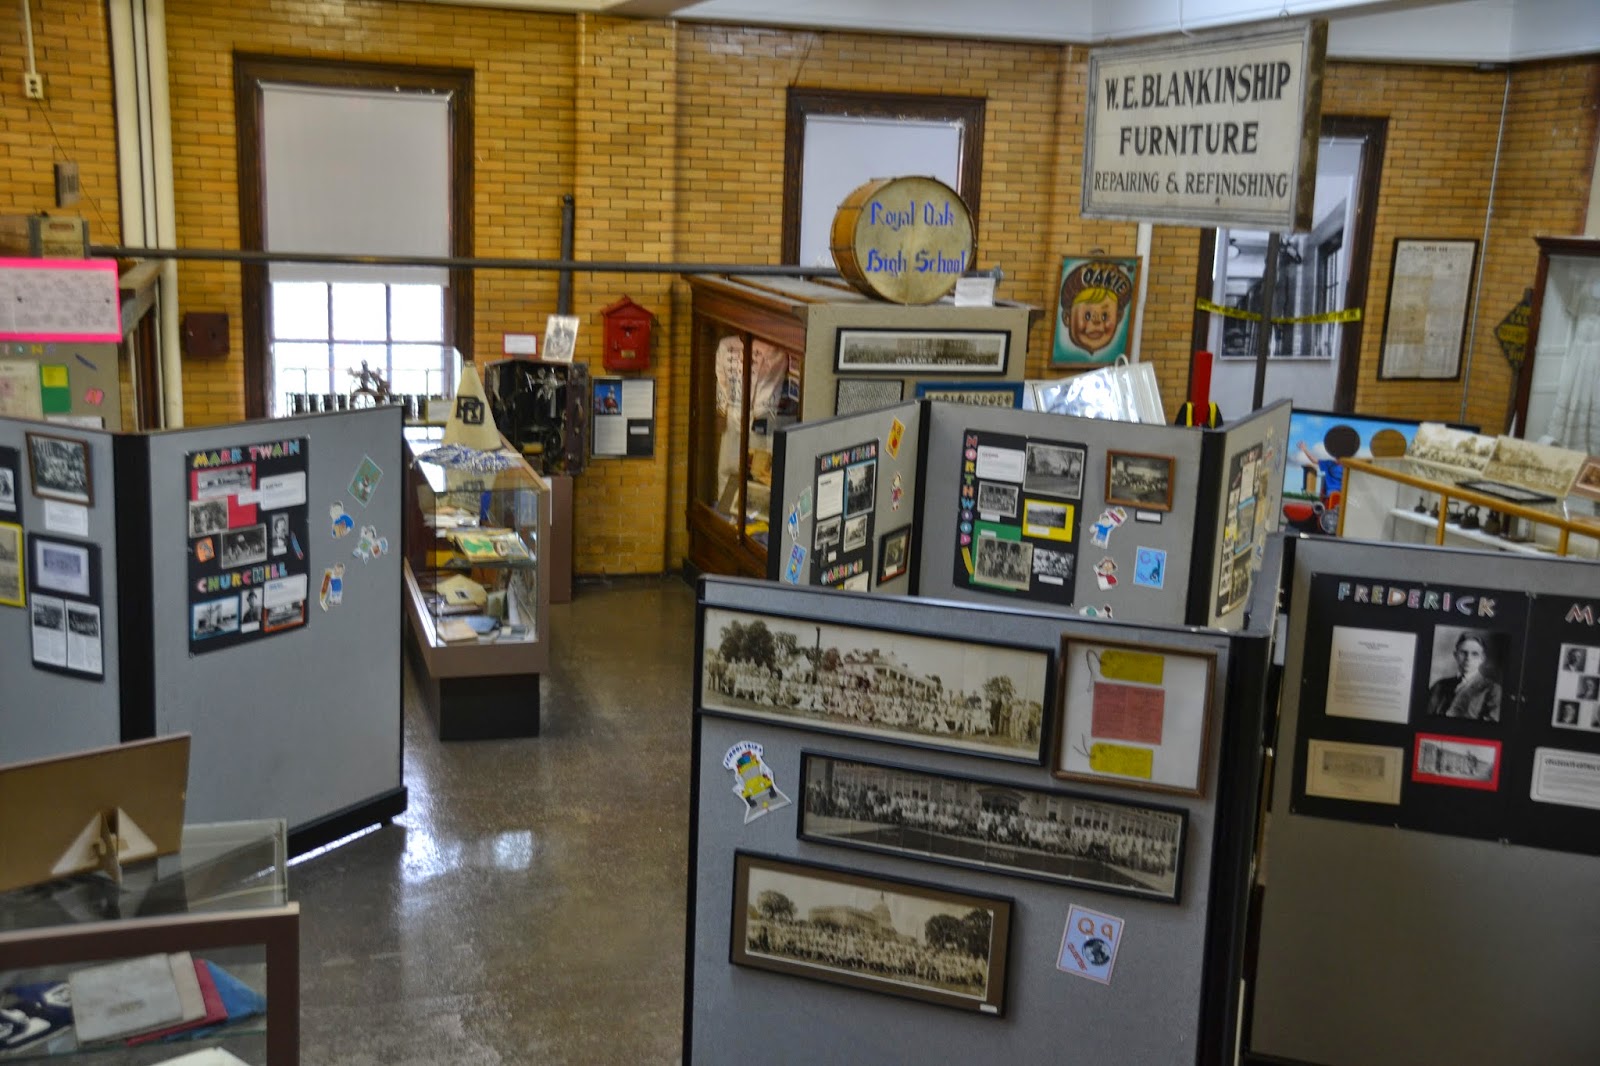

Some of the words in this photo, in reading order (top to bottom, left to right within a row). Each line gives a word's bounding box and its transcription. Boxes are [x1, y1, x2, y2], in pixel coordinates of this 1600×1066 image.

[1119, 121, 1259, 157] FURNITURE
[1094, 171, 1160, 195] REPAIRING
[1166, 172, 1180, 195] &
[1185, 171, 1289, 199] REFINISHING
[870, 200, 915, 232] Royal
[923, 200, 955, 226] Oak
[865, 248, 907, 278] High
[914, 249, 966, 274] School
[1081, 267, 1128, 293] OAKIE
[193, 447, 243, 468] MARK
[249, 440, 300, 461] TWAIN
[821, 453, 849, 472] EDWIN
[850, 443, 876, 463] STARR
[960, 434, 978, 545] NORTHWOOD
[197, 562, 288, 593] CHURCHILL
[1337, 582, 1496, 618] FREDERICK
[1564, 603, 1600, 626] M
[1077, 917, 1095, 936] Q
